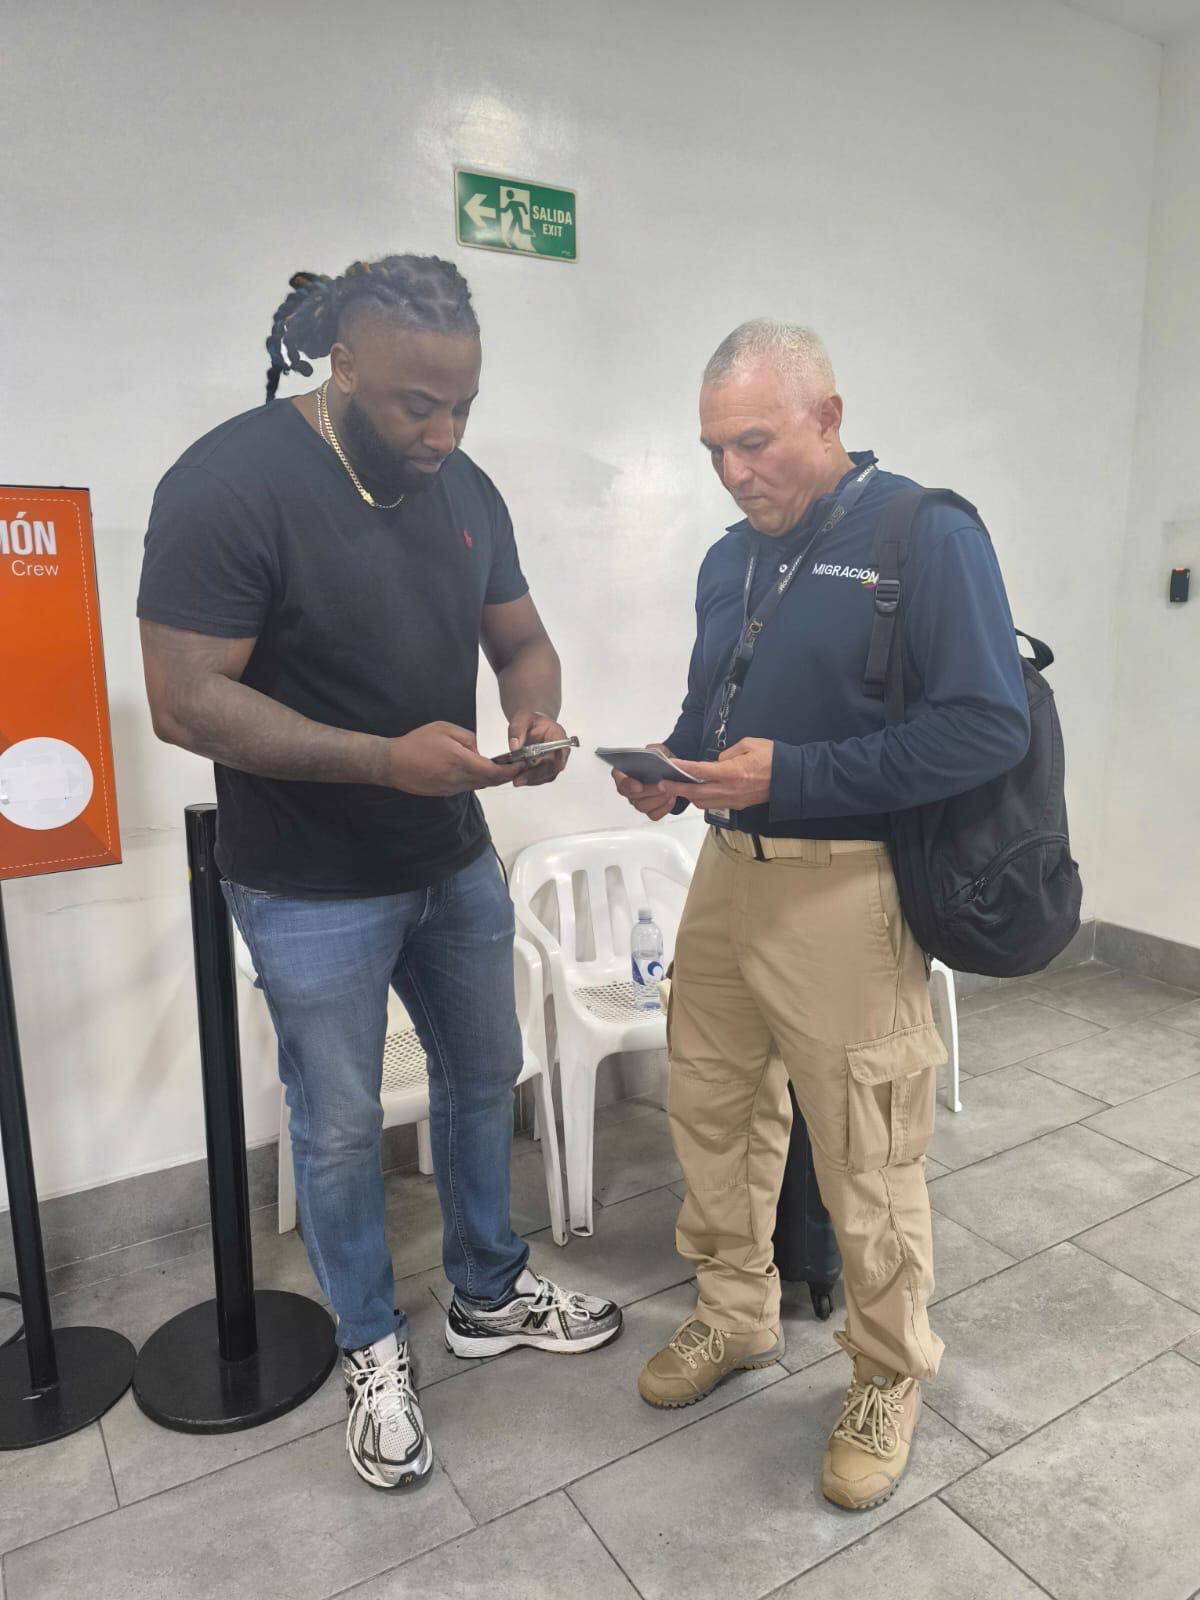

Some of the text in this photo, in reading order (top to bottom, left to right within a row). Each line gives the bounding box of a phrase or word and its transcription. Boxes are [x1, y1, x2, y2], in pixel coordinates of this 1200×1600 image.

[532, 204, 573, 225] SALIDA
[542, 223, 563, 237] EXIT
[11, 559, 59, 577] Crew
[811, 562, 880, 585] MIGRACIÓN
